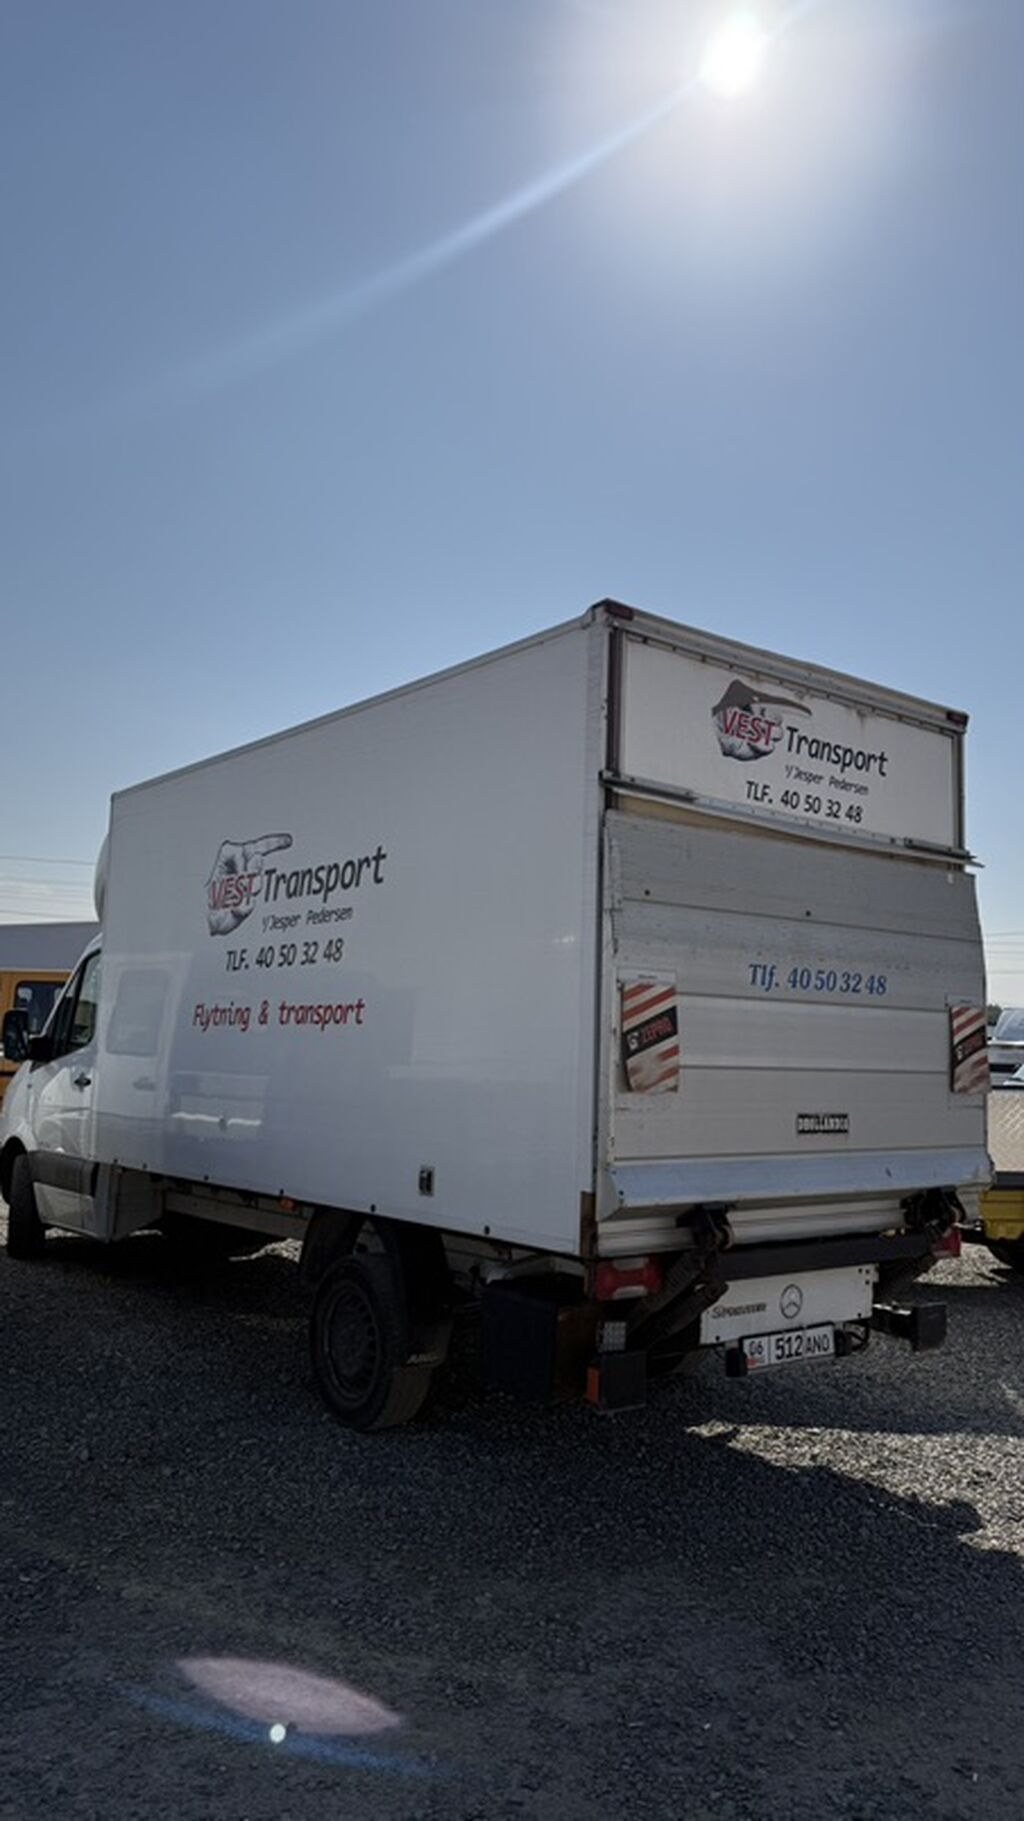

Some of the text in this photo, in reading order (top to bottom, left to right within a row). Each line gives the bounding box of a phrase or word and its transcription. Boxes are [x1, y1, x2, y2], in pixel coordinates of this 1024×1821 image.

[722, 706, 889, 777] VEST Transport
[746, 780, 864, 824] TLF. 40 50 32 48
[210, 845, 387, 910] VEST Transport
[305, 906, 353, 925] Pedersen
[226, 937, 345, 972] TLF. 40 50 32 48
[748, 963, 888, 996] Tlf. 40 50 32 48
[192, 998, 366, 1033] Flytning & transport
[775, 1335, 803, 1360] 512
